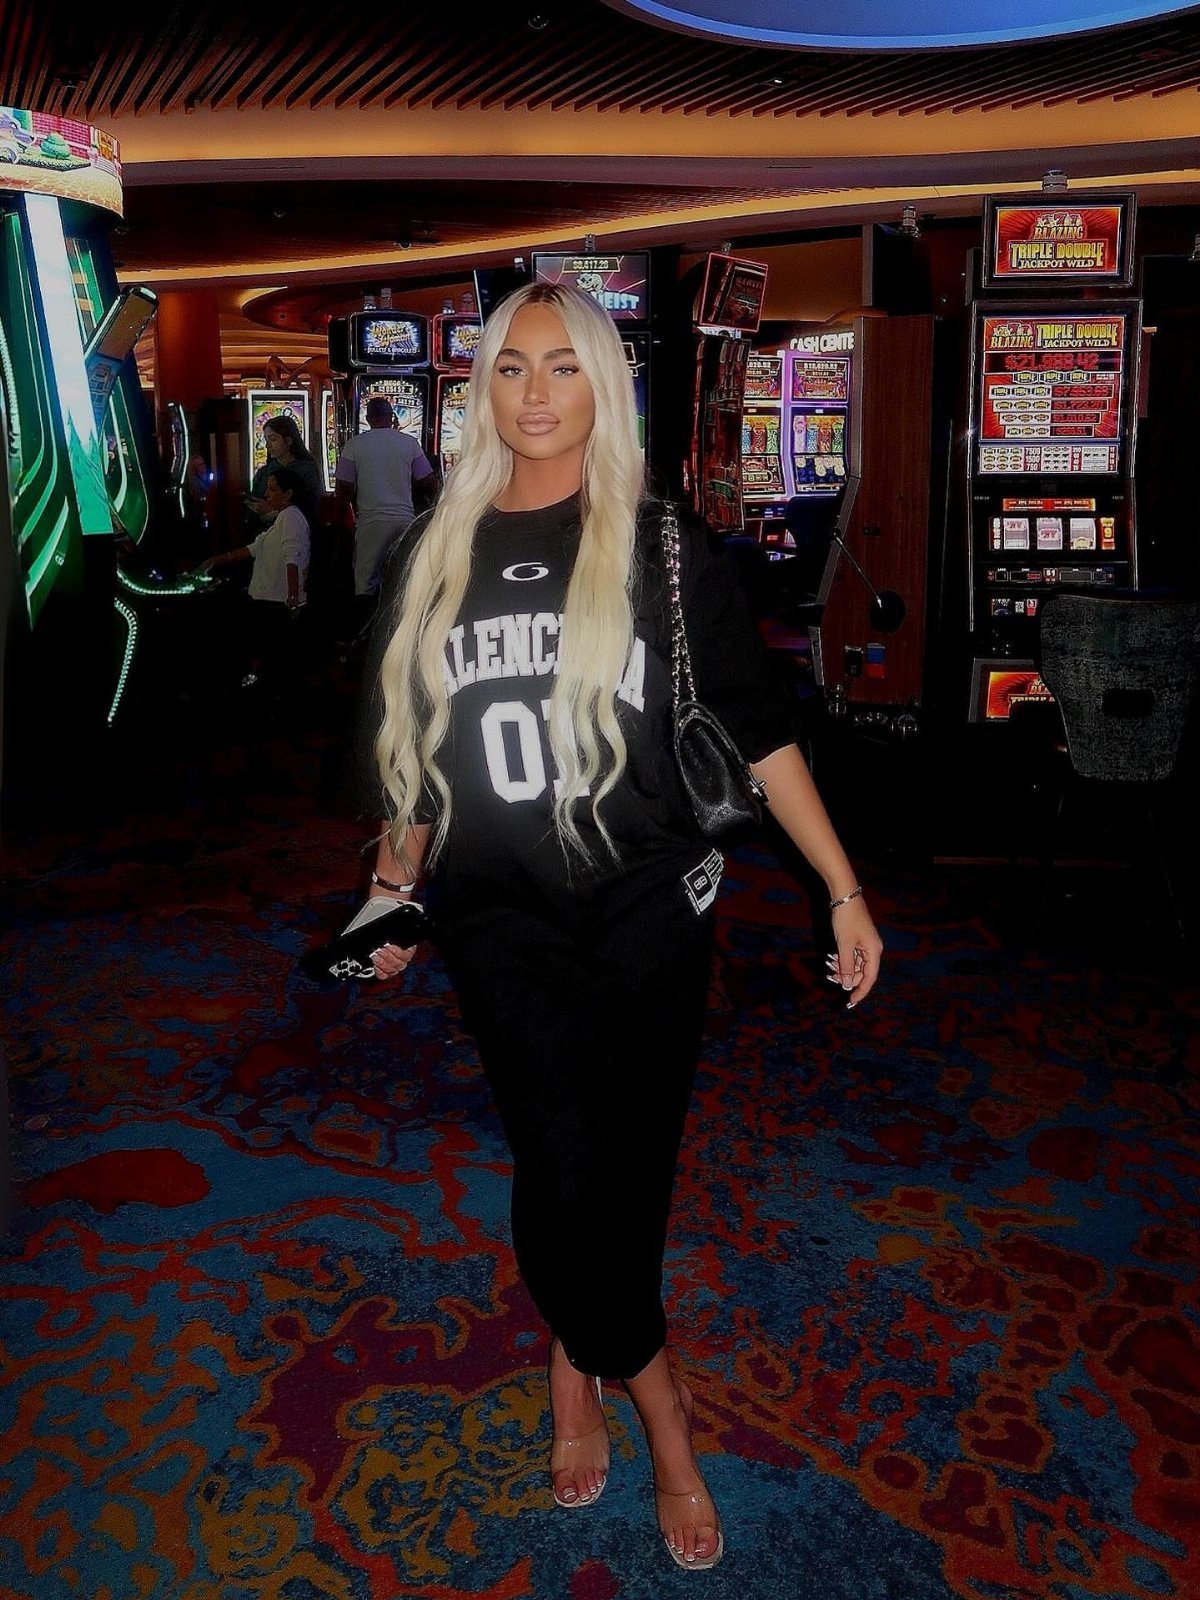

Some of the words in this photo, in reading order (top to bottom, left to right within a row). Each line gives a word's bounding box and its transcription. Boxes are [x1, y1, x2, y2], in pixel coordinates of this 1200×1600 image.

[1033, 226, 1084, 239] BLAZING
[1010, 243, 1054, 268] TRIPLE
[1056, 242, 1104, 267] DOUBLE
[1018, 259, 1066, 269] JACKPOT
[1066, 259, 1095, 268] WILD
[1036, 324, 1074, 347] TRIPLE
[1077, 323, 1118, 346] DOUBLE
[820, 332, 855, 352] CENTE
[990, 336, 1034, 349] BLAZING
[1042, 339, 1083, 349] JACKPOT
[1085, 338, 1110, 347] WILD
